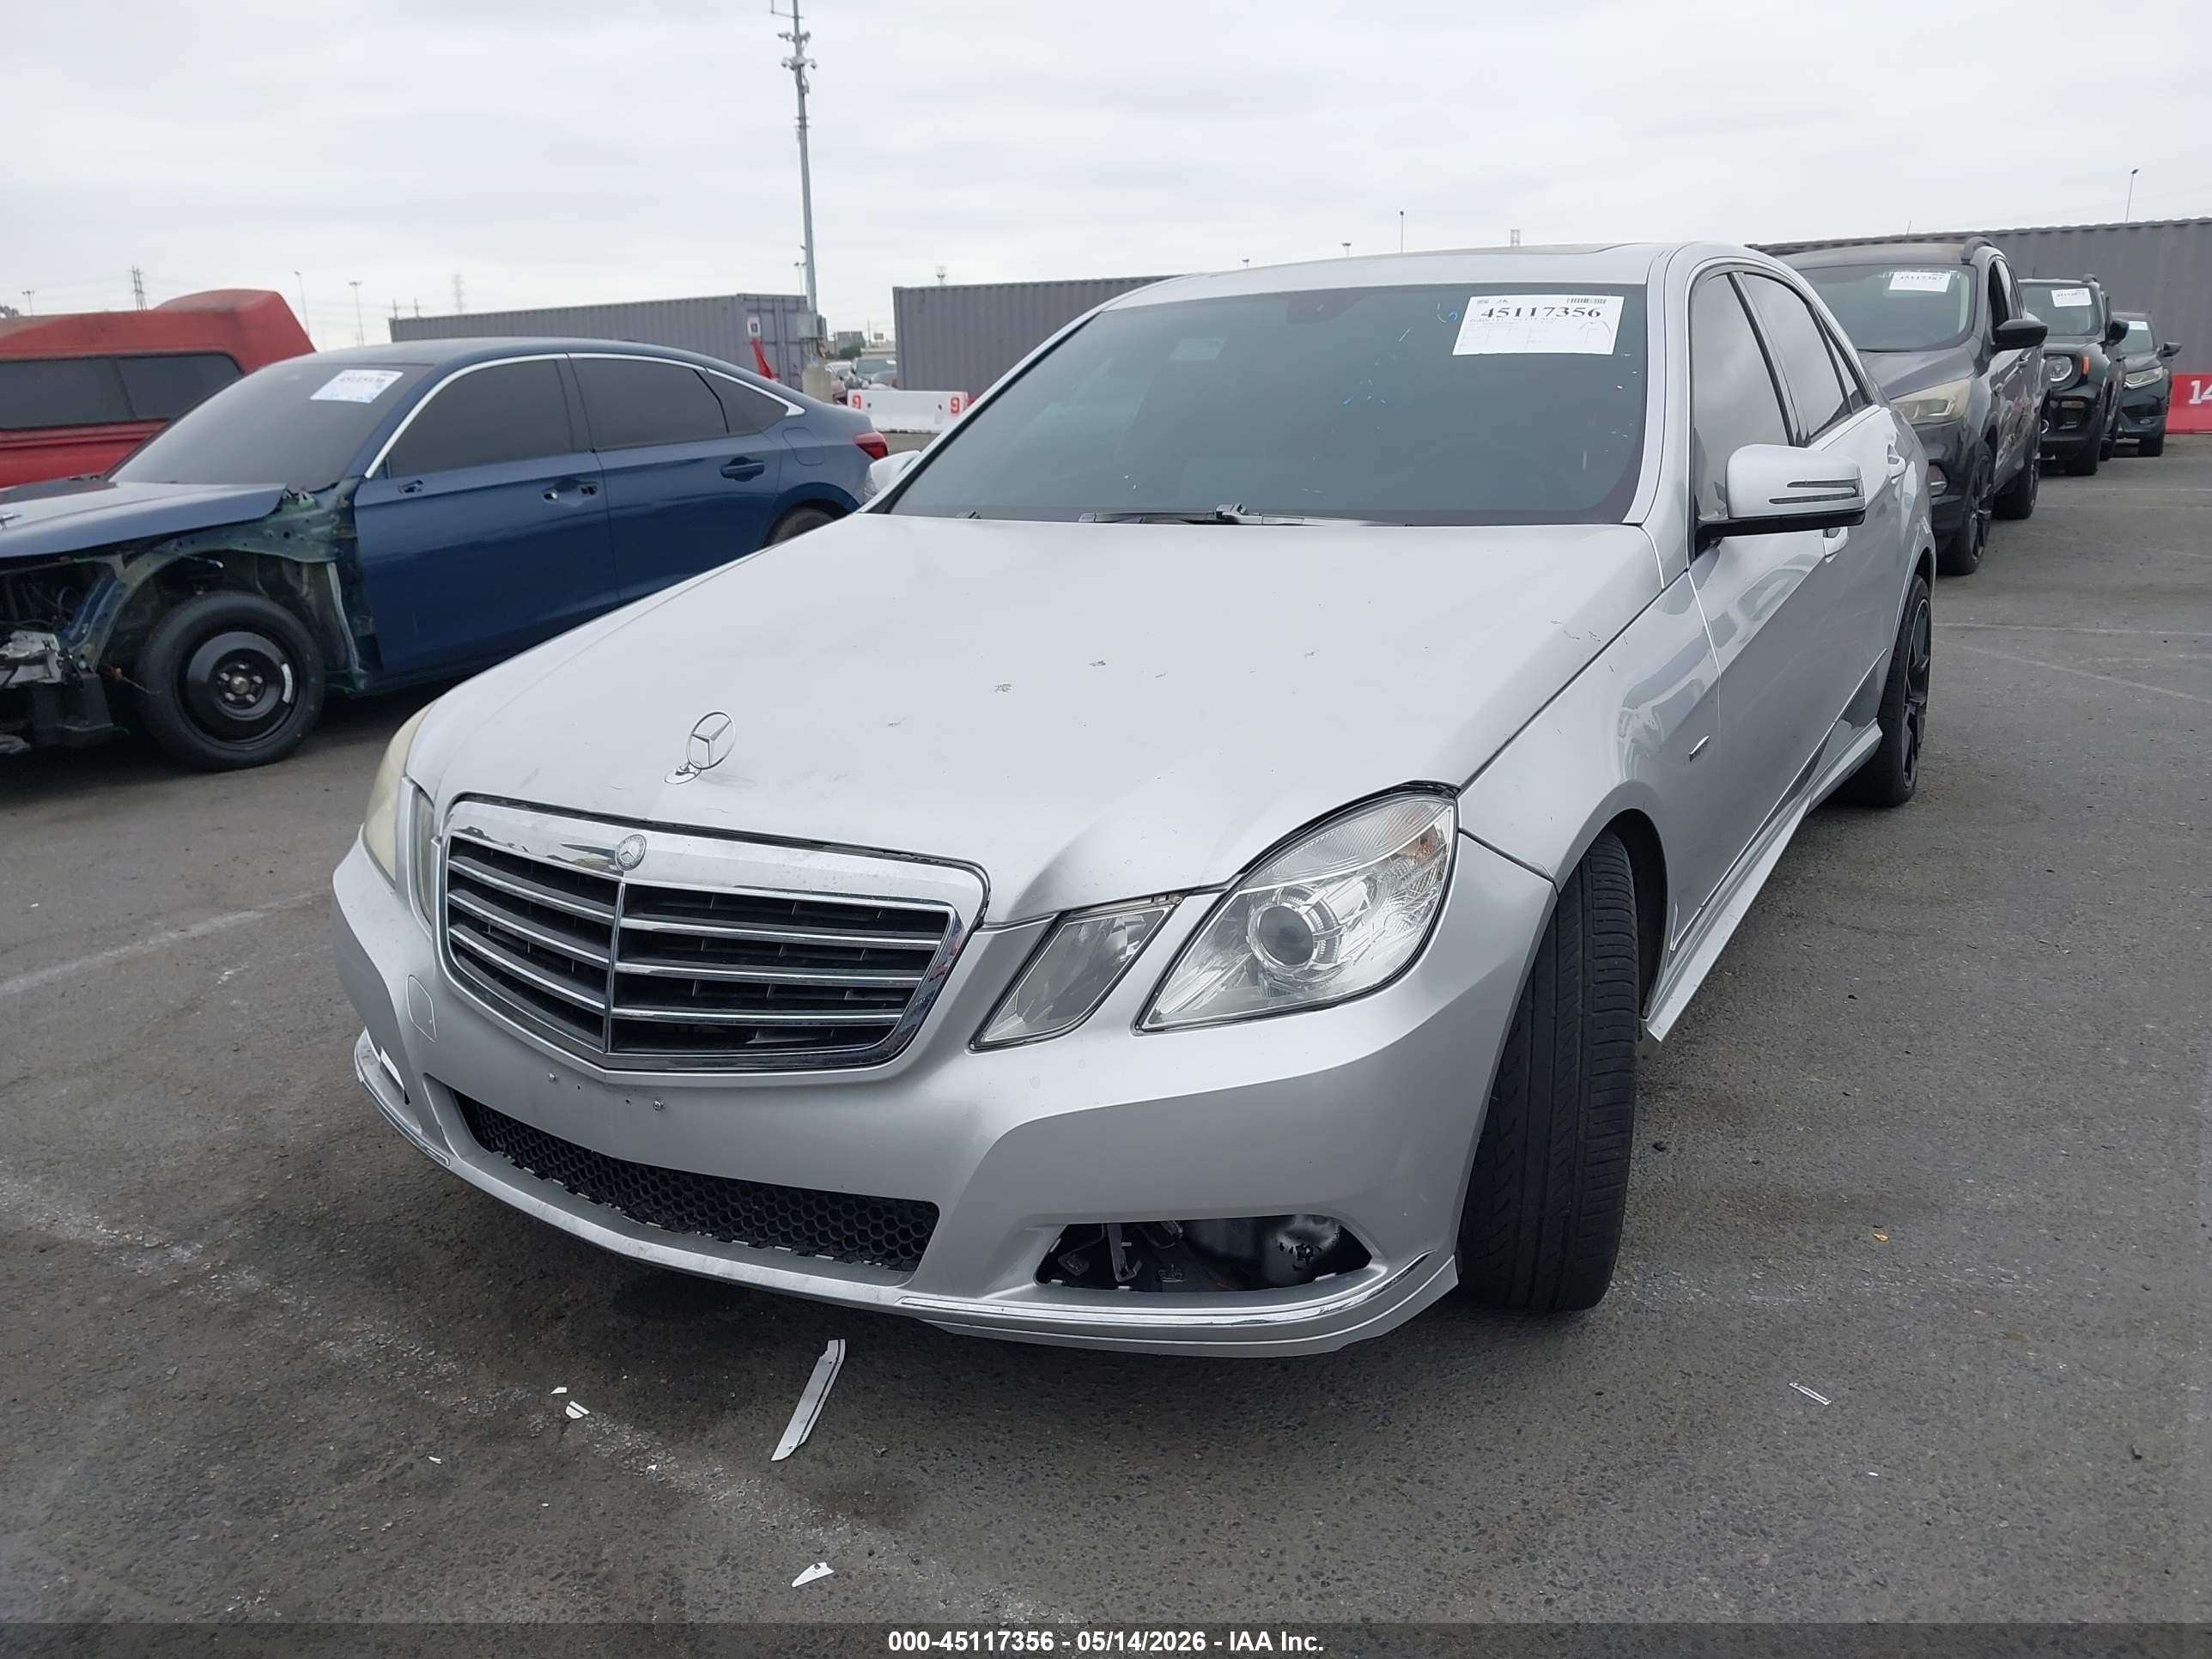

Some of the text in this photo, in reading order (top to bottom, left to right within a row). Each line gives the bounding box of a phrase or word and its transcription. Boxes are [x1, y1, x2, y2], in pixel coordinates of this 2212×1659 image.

[1480, 307, 1601, 318] 45117356
[852, 395, 861, 410] 9
[950, 397, 960, 413] 9
